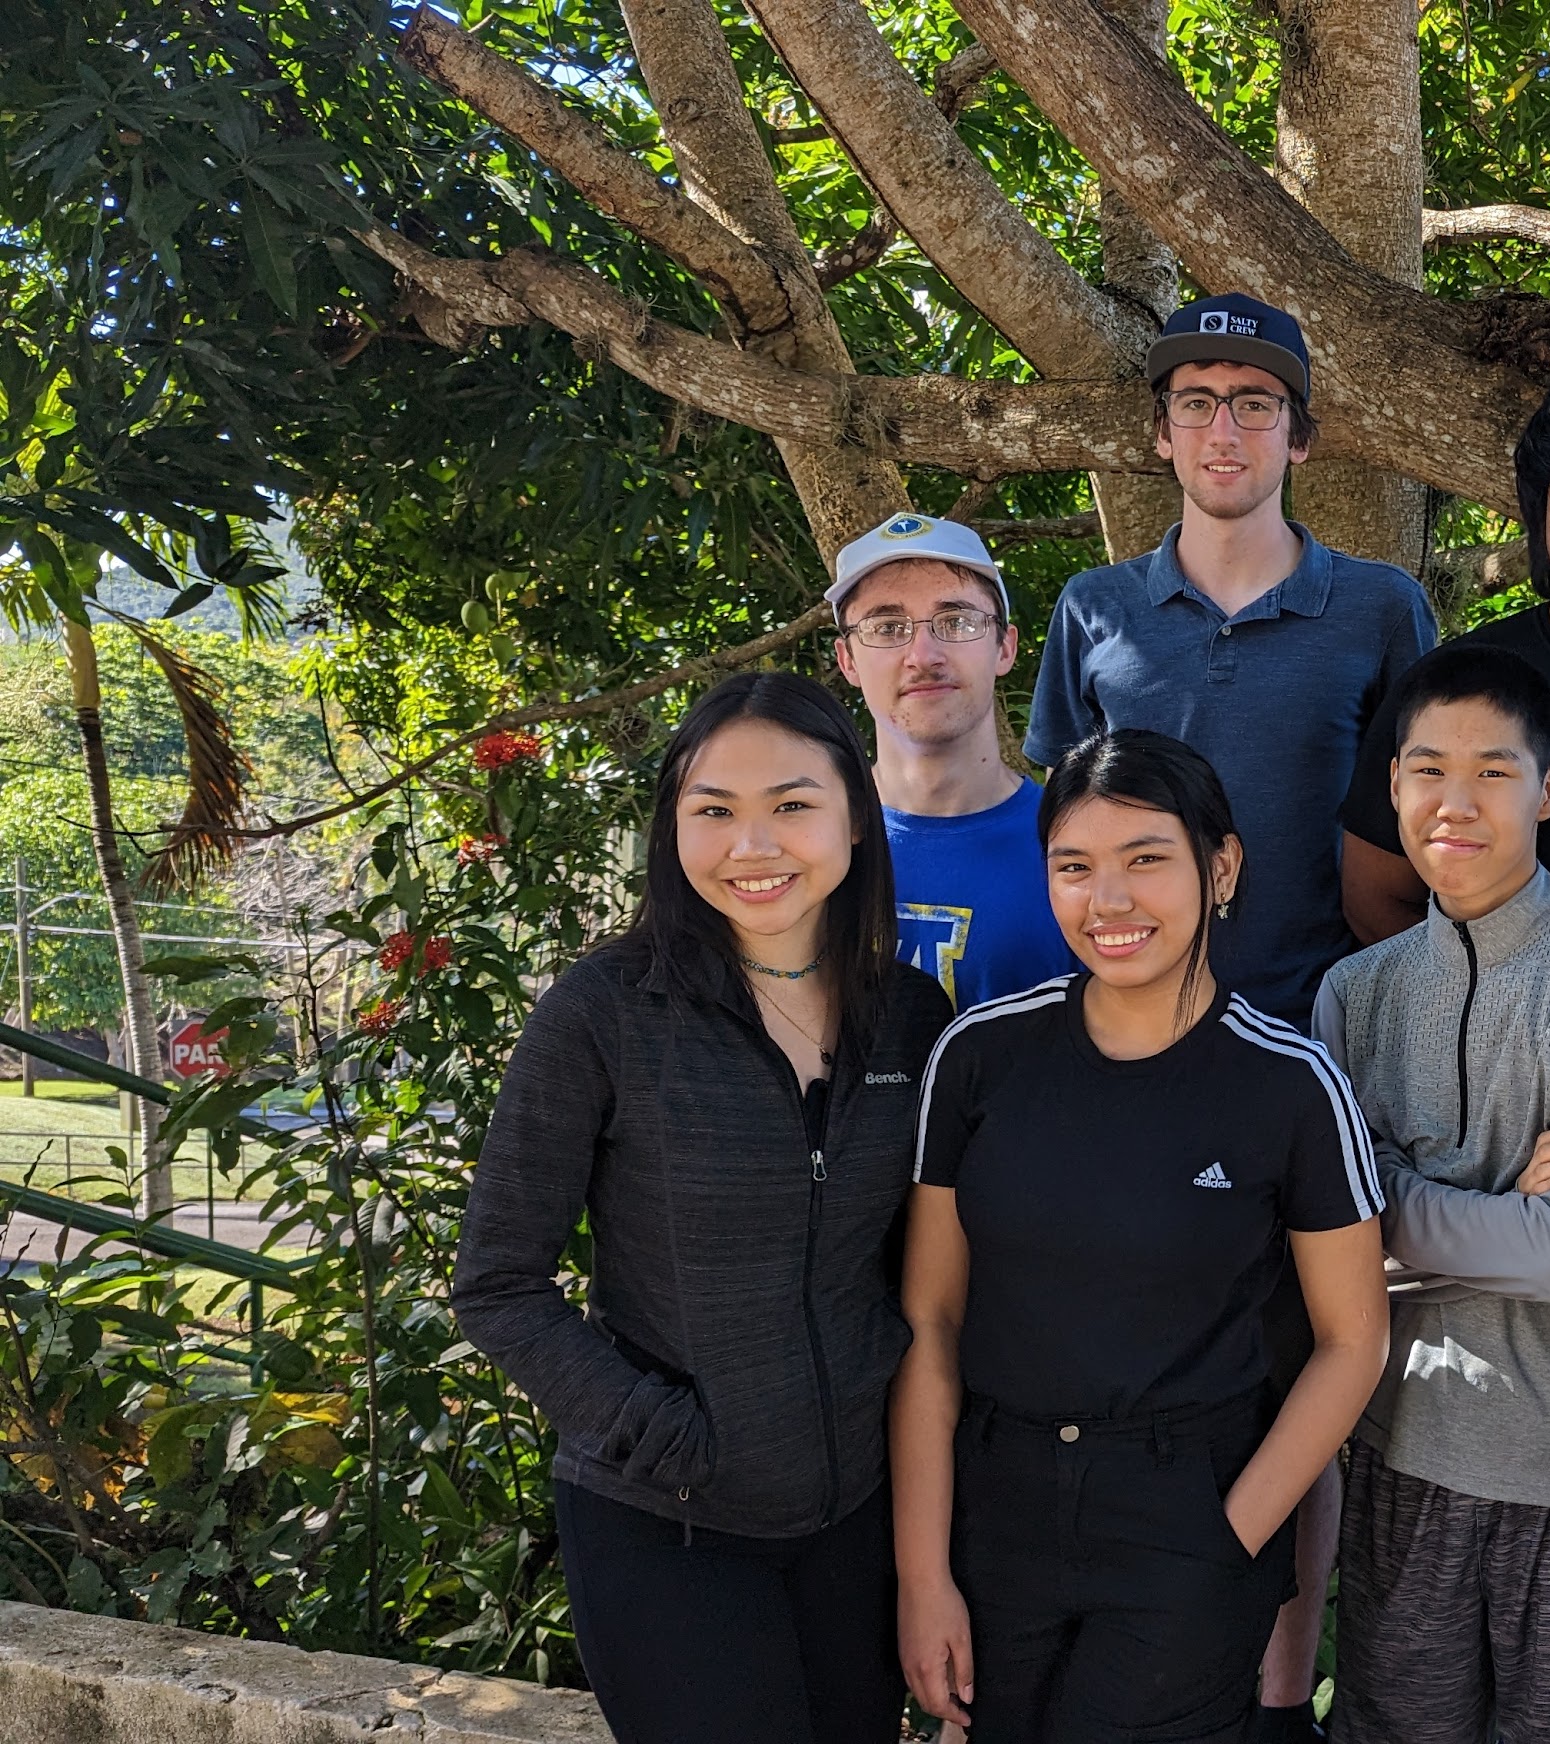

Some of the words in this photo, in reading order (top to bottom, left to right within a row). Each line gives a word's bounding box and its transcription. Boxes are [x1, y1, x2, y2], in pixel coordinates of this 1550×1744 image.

[1230, 315, 1258, 328] SALTY
[1230, 325, 1257, 336] CREW
[174, 1043, 247, 1065] PAR
[865, 1071, 911, 1084] Bench.
[1193, 1177, 1231, 1189] adidas
